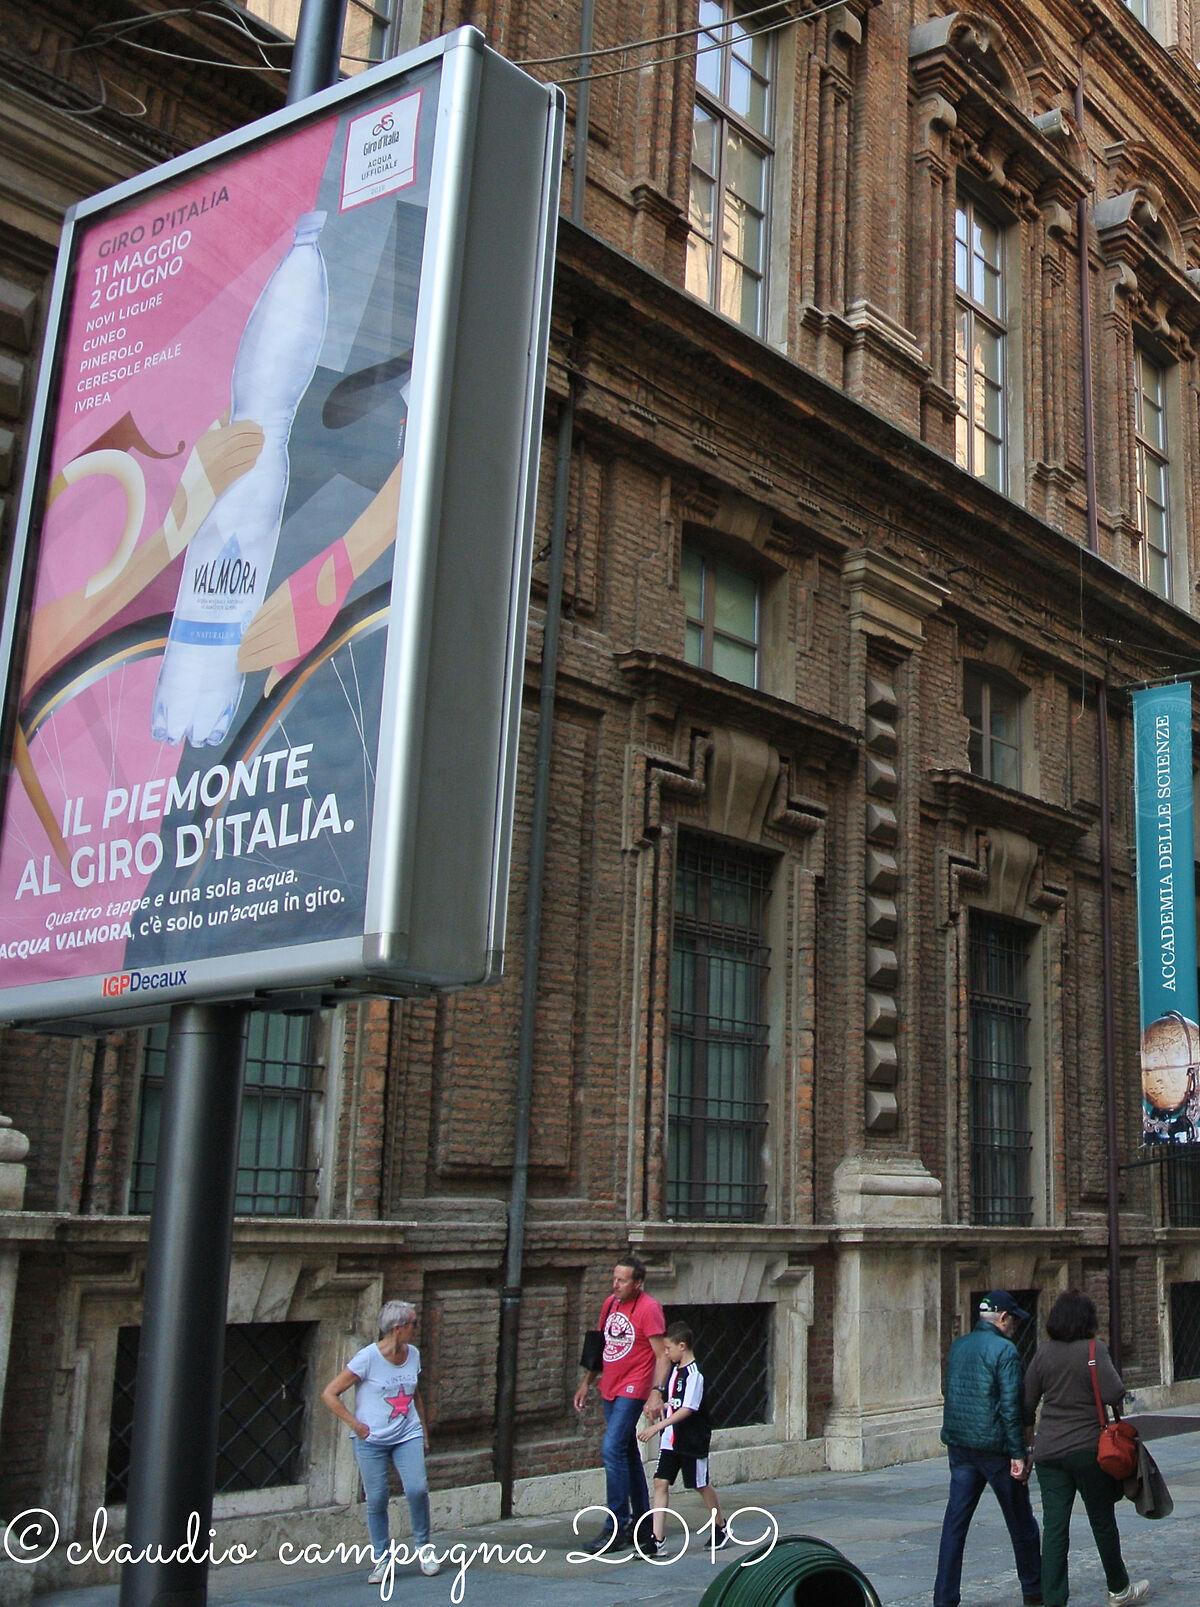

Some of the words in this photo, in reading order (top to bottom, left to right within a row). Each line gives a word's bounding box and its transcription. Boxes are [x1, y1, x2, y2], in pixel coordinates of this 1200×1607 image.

[363, 140, 377, 156] Giro
[378, 131, 400, 149] d'Italia
[367, 153, 392, 169] ACQUA
[361, 160, 398, 181] UFFICIALE
[98, 225, 145, 259] GIRO
[151, 186, 230, 238] D'ITALIA
[89, 289, 101, 310] 2
[106, 255, 184, 302] GIUGNO
[94, 264, 109, 286] 11
[112, 230, 193, 279] MAGGIO
[86, 311, 115, 333] NOVI
[119, 292, 164, 320] LIGURE
[79, 341, 144, 373] PINEROLO
[82, 328, 127, 352] CUNEO
[77, 361, 141, 393] CERESOLE
[143, 343, 182, 370] REALE
[74, 391, 111, 414] IVREA
[193, 558, 257, 594] VALMORA
[1156, 714, 1172, 799] SCIENZE
[62, 798, 91, 839] IL
[102, 743, 314, 830] PIEMONTE
[14, 858, 61, 901] AL
[70, 831, 164, 889] GIRO
[175, 793, 355, 868] D'ITALIA.
[1157, 802, 1173, 870] DELLE
[0, 936, 50, 960] ACQUA
[55, 923, 135, 951] VALMORA,
[140, 917, 161, 936] c'è
[166, 910, 203, 932] solo
[207, 899, 279, 926] un'acqua
[284, 892, 299, 911] in
[305, 886, 345, 913] giro.
[45, 906, 102, 931] Quattro
[106, 896, 150, 918] tappe
[154, 893, 164, 907] e
[169, 887, 200, 905] una
[206, 878, 240, 899] sola
[246, 869, 298, 893] acqua.
[1159, 873, 1176, 992] ACCADEMIA
[102, 970, 187, 998] IGPDecaux
